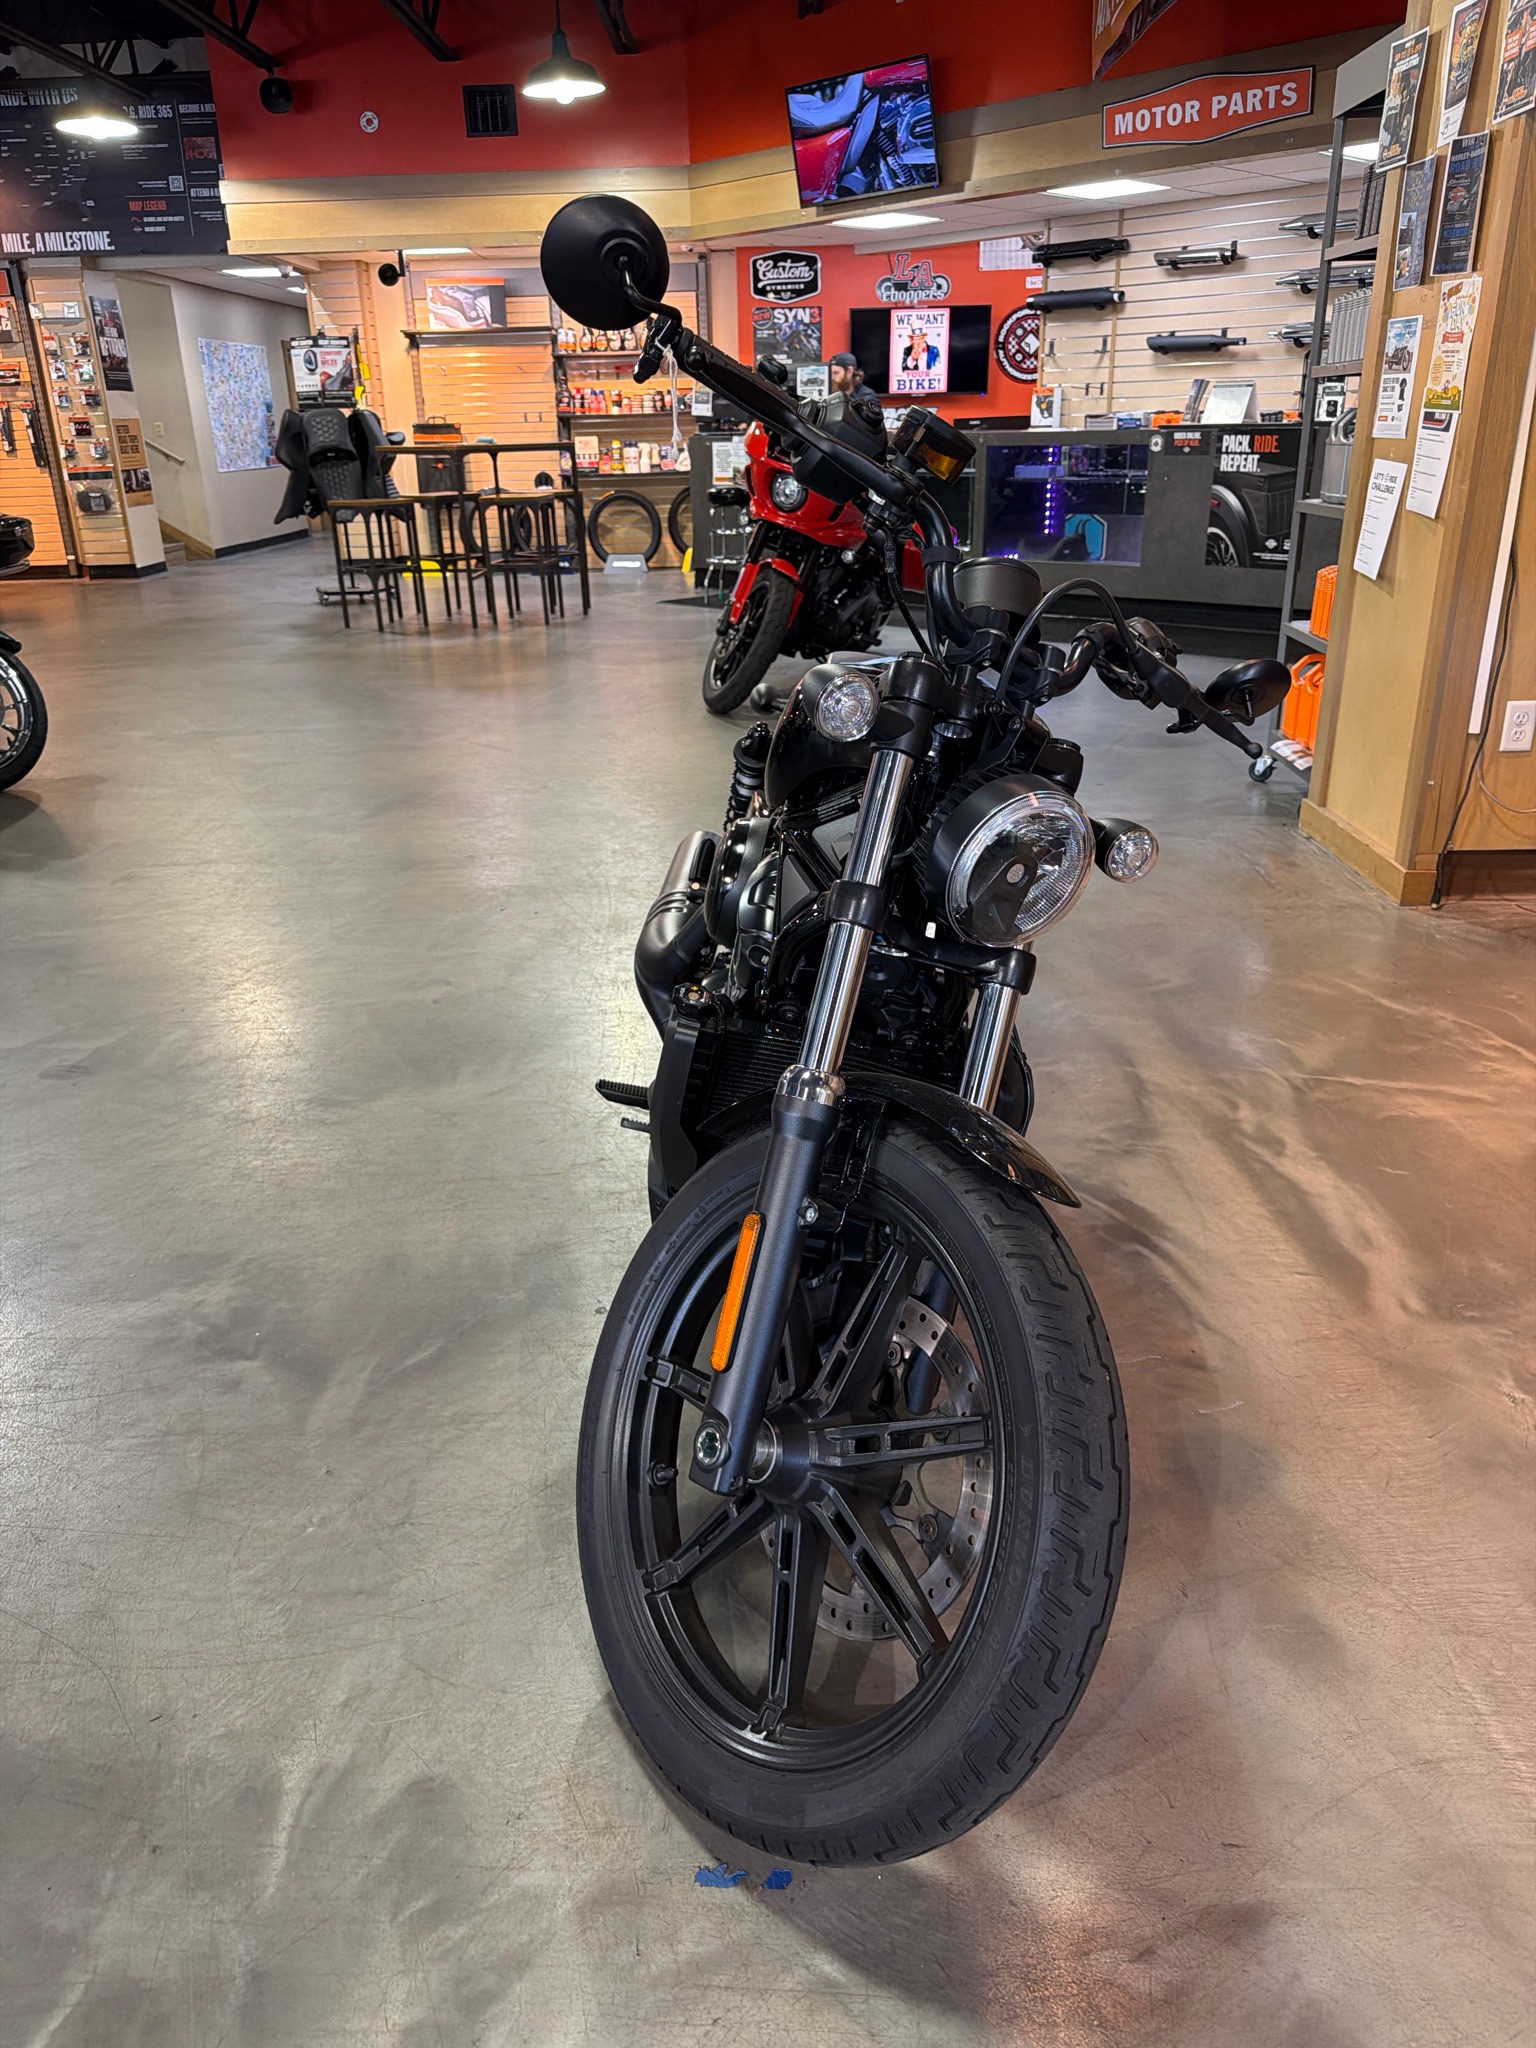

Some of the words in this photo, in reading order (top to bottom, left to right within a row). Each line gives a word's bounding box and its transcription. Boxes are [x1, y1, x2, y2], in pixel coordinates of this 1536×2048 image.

[138, 105, 156, 118] RIDE
[156, 105, 173, 118] 365
[1114, 100, 1200, 136] MOTOR
[1211, 82, 1298, 119] PARTS
[1, 233, 35, 255] MILE,
[35, 232, 45, 252] A
[44, 231, 115, 252] MILESTONE.
[756, 259, 815, 288] Custom
[773, 307, 820, 323] SYN3
[896, 314, 913, 326] WE
[916, 313, 945, 325] WANT
[896, 379, 941, 391] BIKE!
[1222, 435, 1252, 452] PACK.
[1253, 435, 1280, 452] RIDE.
[1220, 454, 1261, 472] REPEAT.
